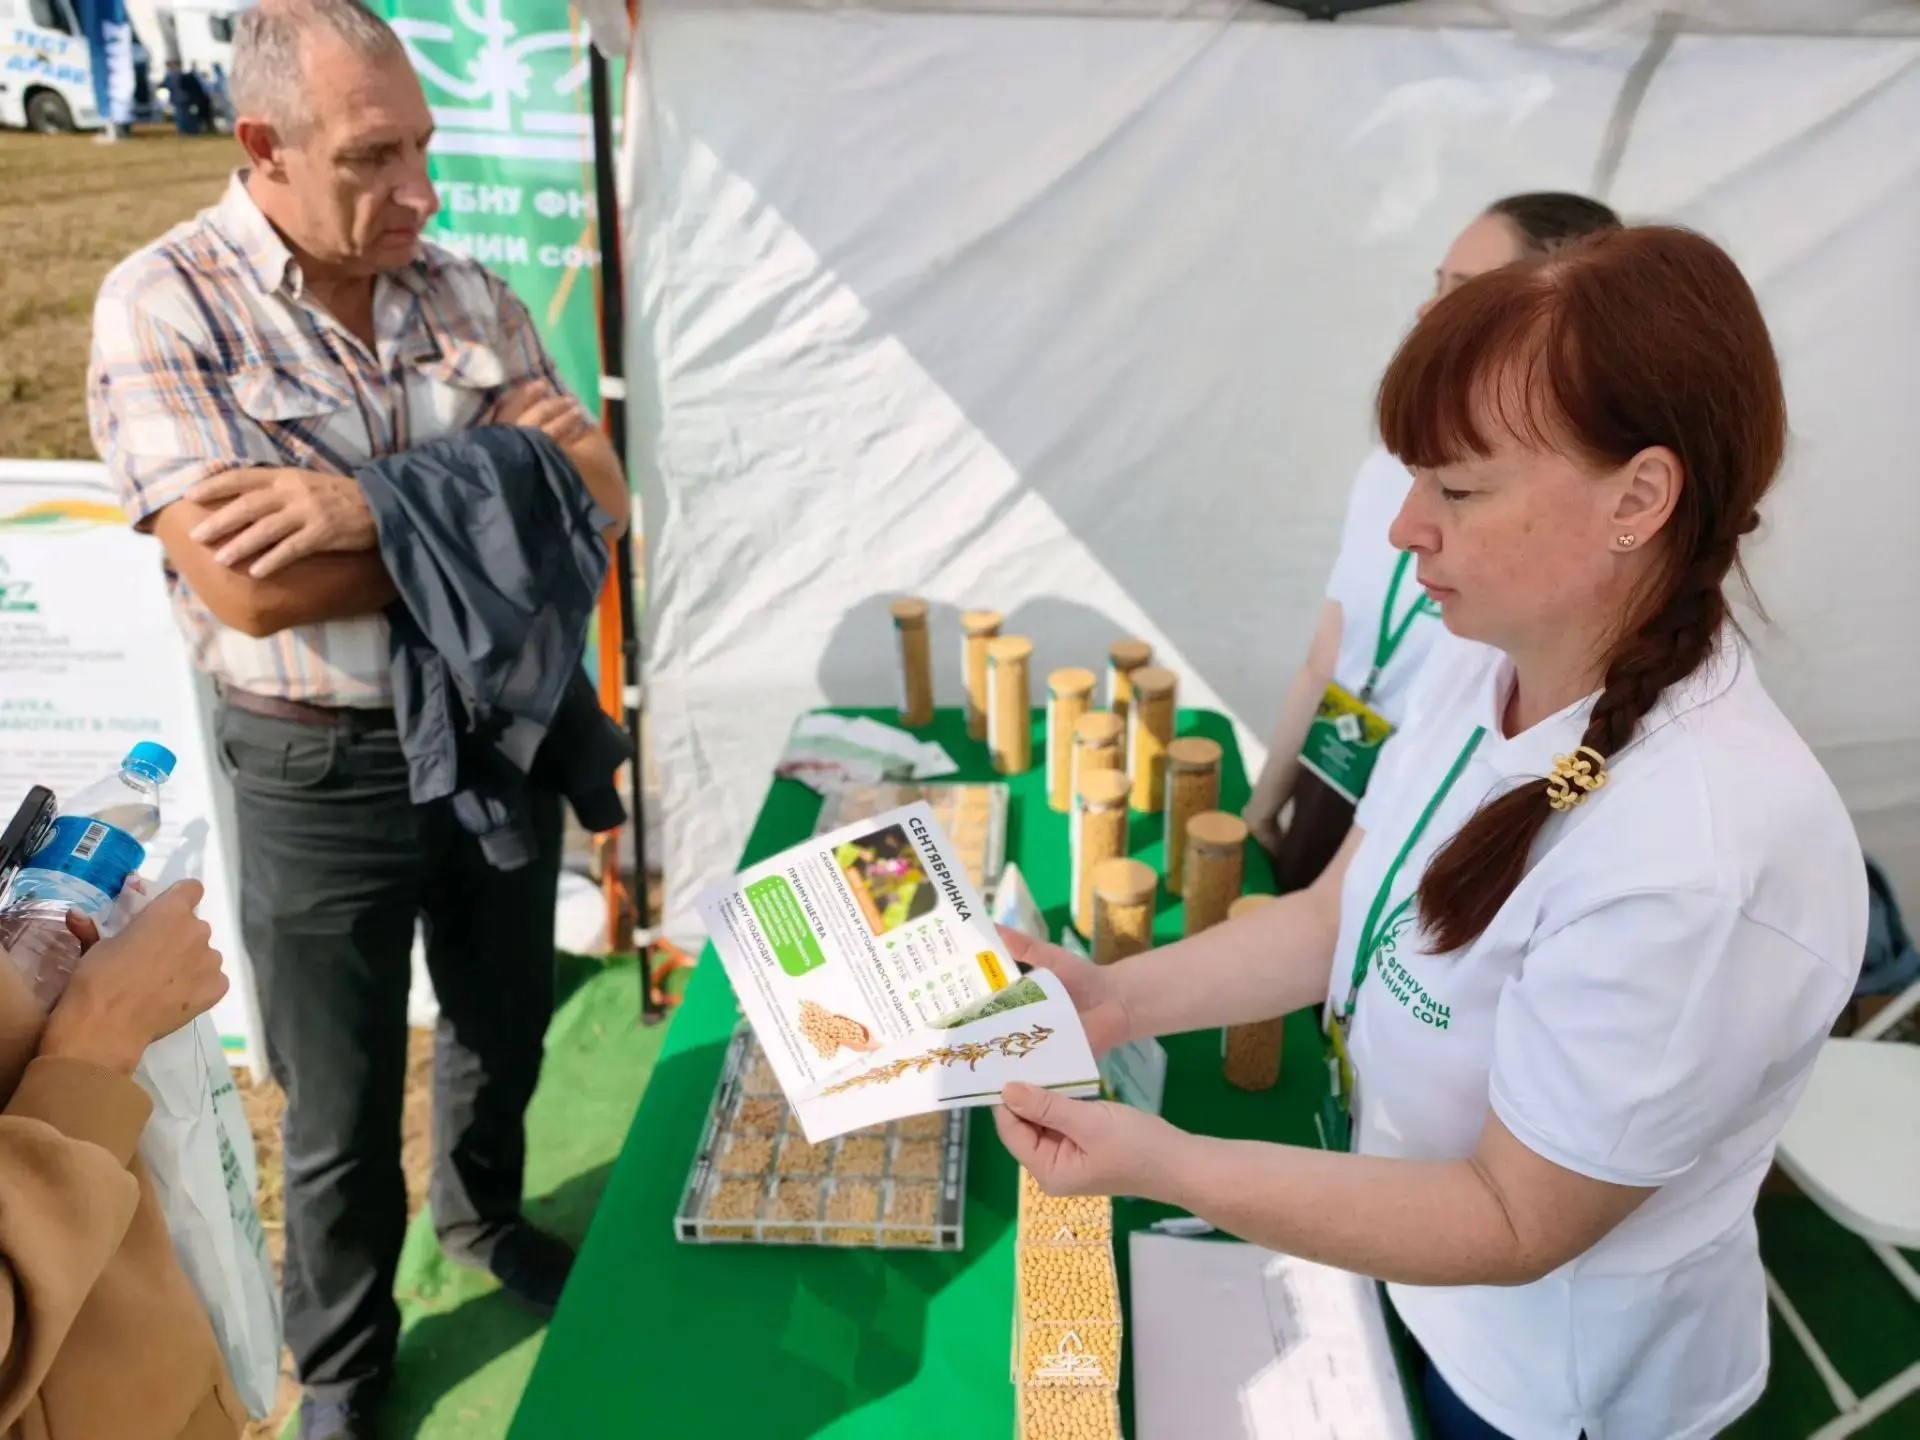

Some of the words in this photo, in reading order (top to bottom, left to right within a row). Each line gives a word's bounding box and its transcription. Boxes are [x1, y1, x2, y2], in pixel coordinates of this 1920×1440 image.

[15, 29, 69, 54] ТЕСТ
[434, 181, 522, 216] ГБНУ
[533, 187, 597, 221] ФН
[819, 850, 857, 917] СКОРОСПЕЛОСТЬ
[907, 815, 973, 921] СЕНТЯБРИНКА
[731, 892, 749, 916] КОМУ
[744, 917, 774, 967] ПОДХОДИТ
[786, 867, 827, 938] ПРЕИМУЩЕСТВА
[853, 917, 861, 925] И
[855, 924, 893, 989] УСТОЙЧИВОСТЬ
[1388, 956, 1424, 995] ФГБНУ
[1420, 992, 1451, 1019] ФНЦ
[890, 995, 911, 1028] ОДНОМ
[1381, 968, 1410, 1006] ВНИИ
[1412, 1005, 1450, 1030] СОИ
